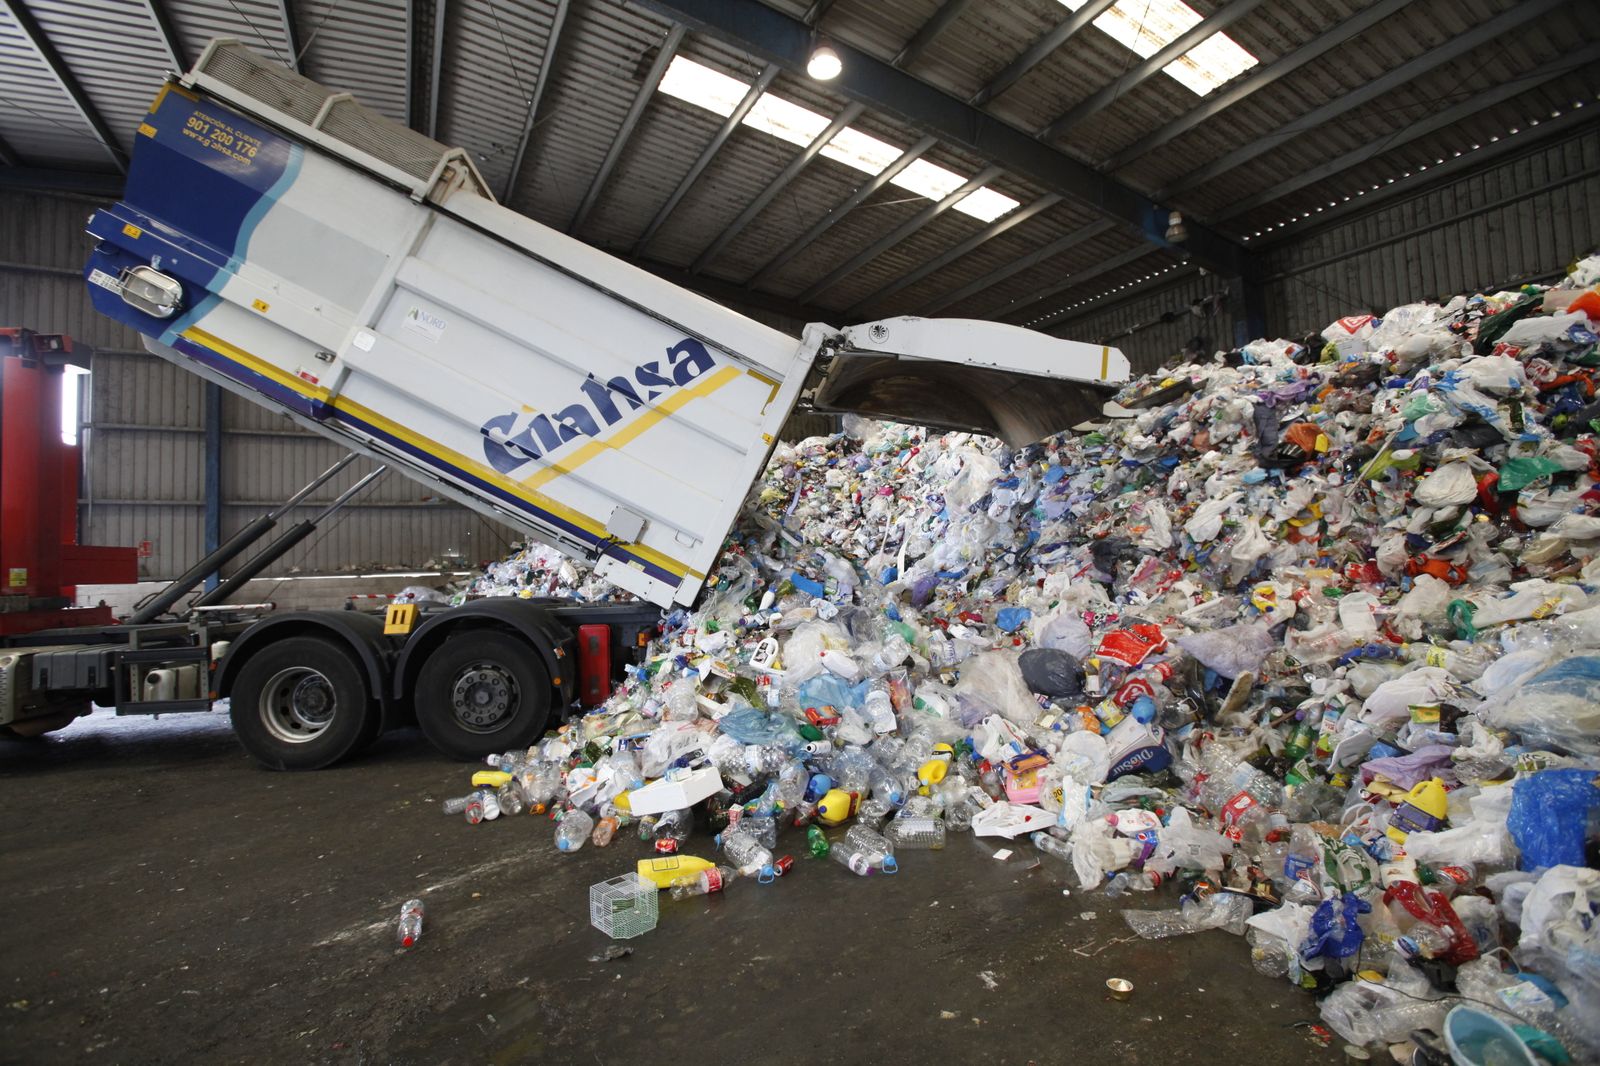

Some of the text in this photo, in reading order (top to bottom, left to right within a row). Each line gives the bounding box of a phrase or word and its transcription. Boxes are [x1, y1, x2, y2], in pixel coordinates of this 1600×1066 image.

[186, 117, 257, 157] 901 200 176
